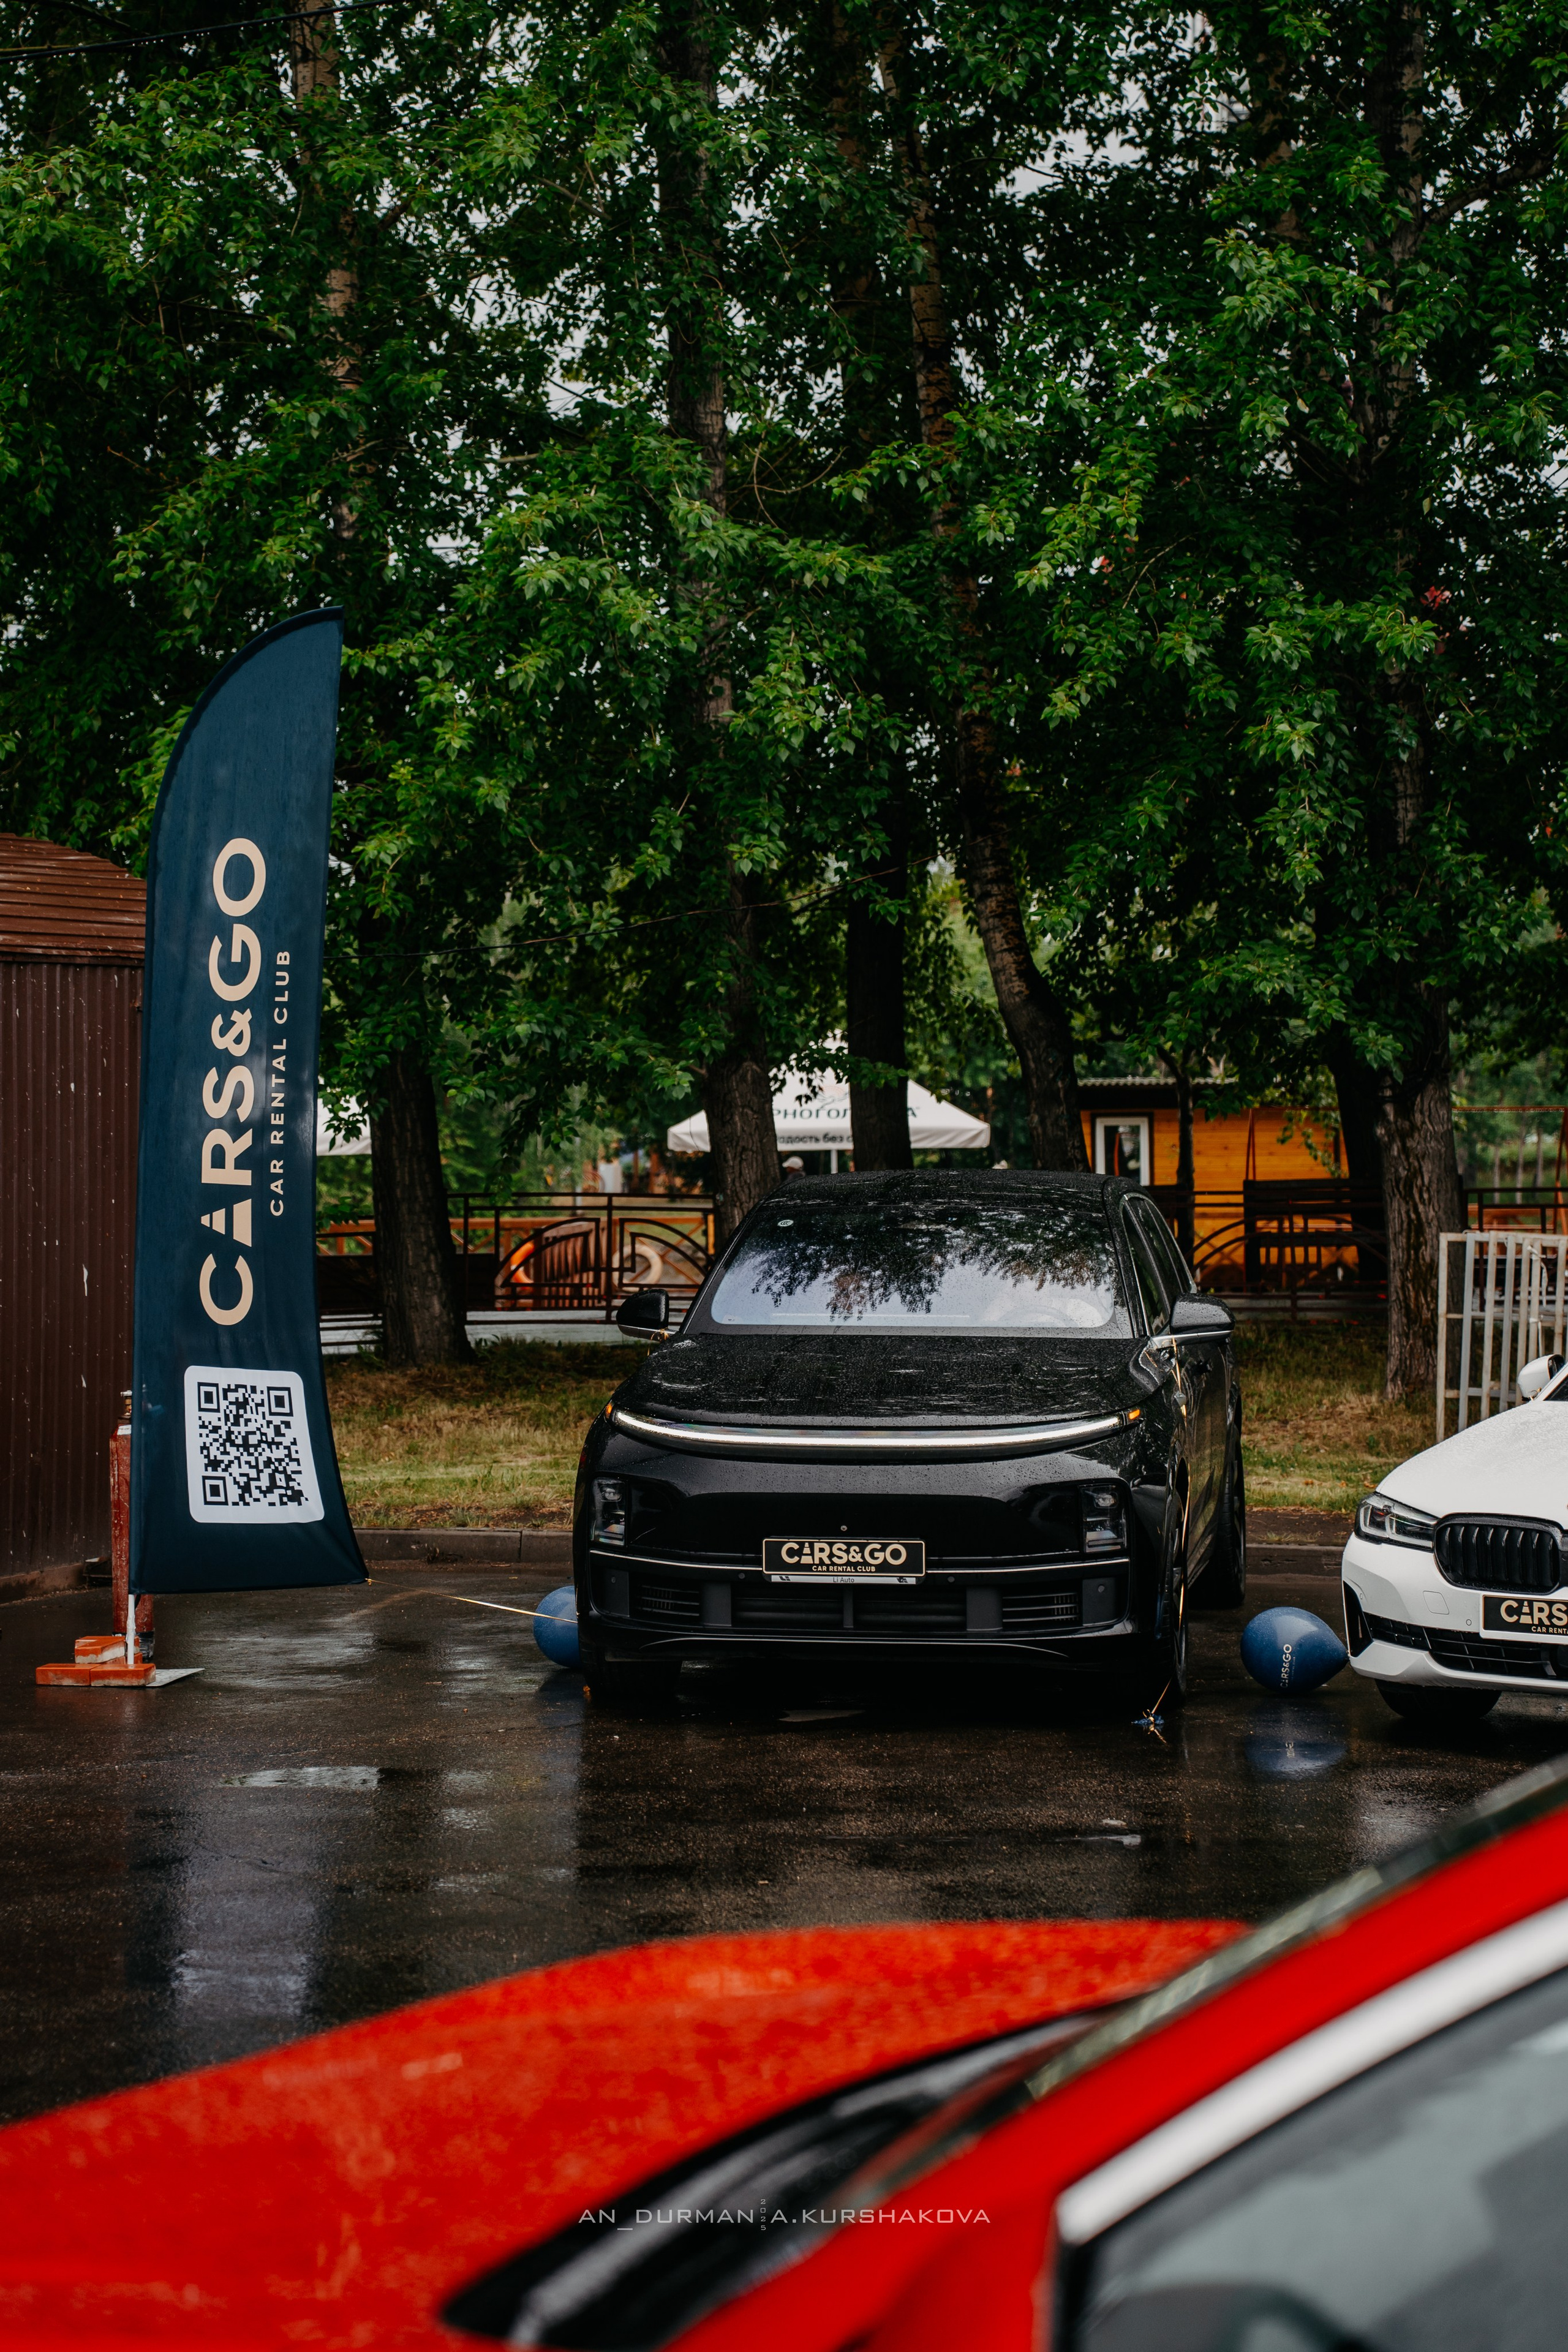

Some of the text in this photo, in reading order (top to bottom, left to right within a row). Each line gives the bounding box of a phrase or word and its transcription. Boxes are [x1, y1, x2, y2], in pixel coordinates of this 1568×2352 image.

[199, 838, 266, 1325] CARS&GO
[270, 951, 290, 1216] CAR RENTAL CLUB
[777, 1135, 820, 1145] адость
[781, 1542, 907, 1565] CARS&GO
